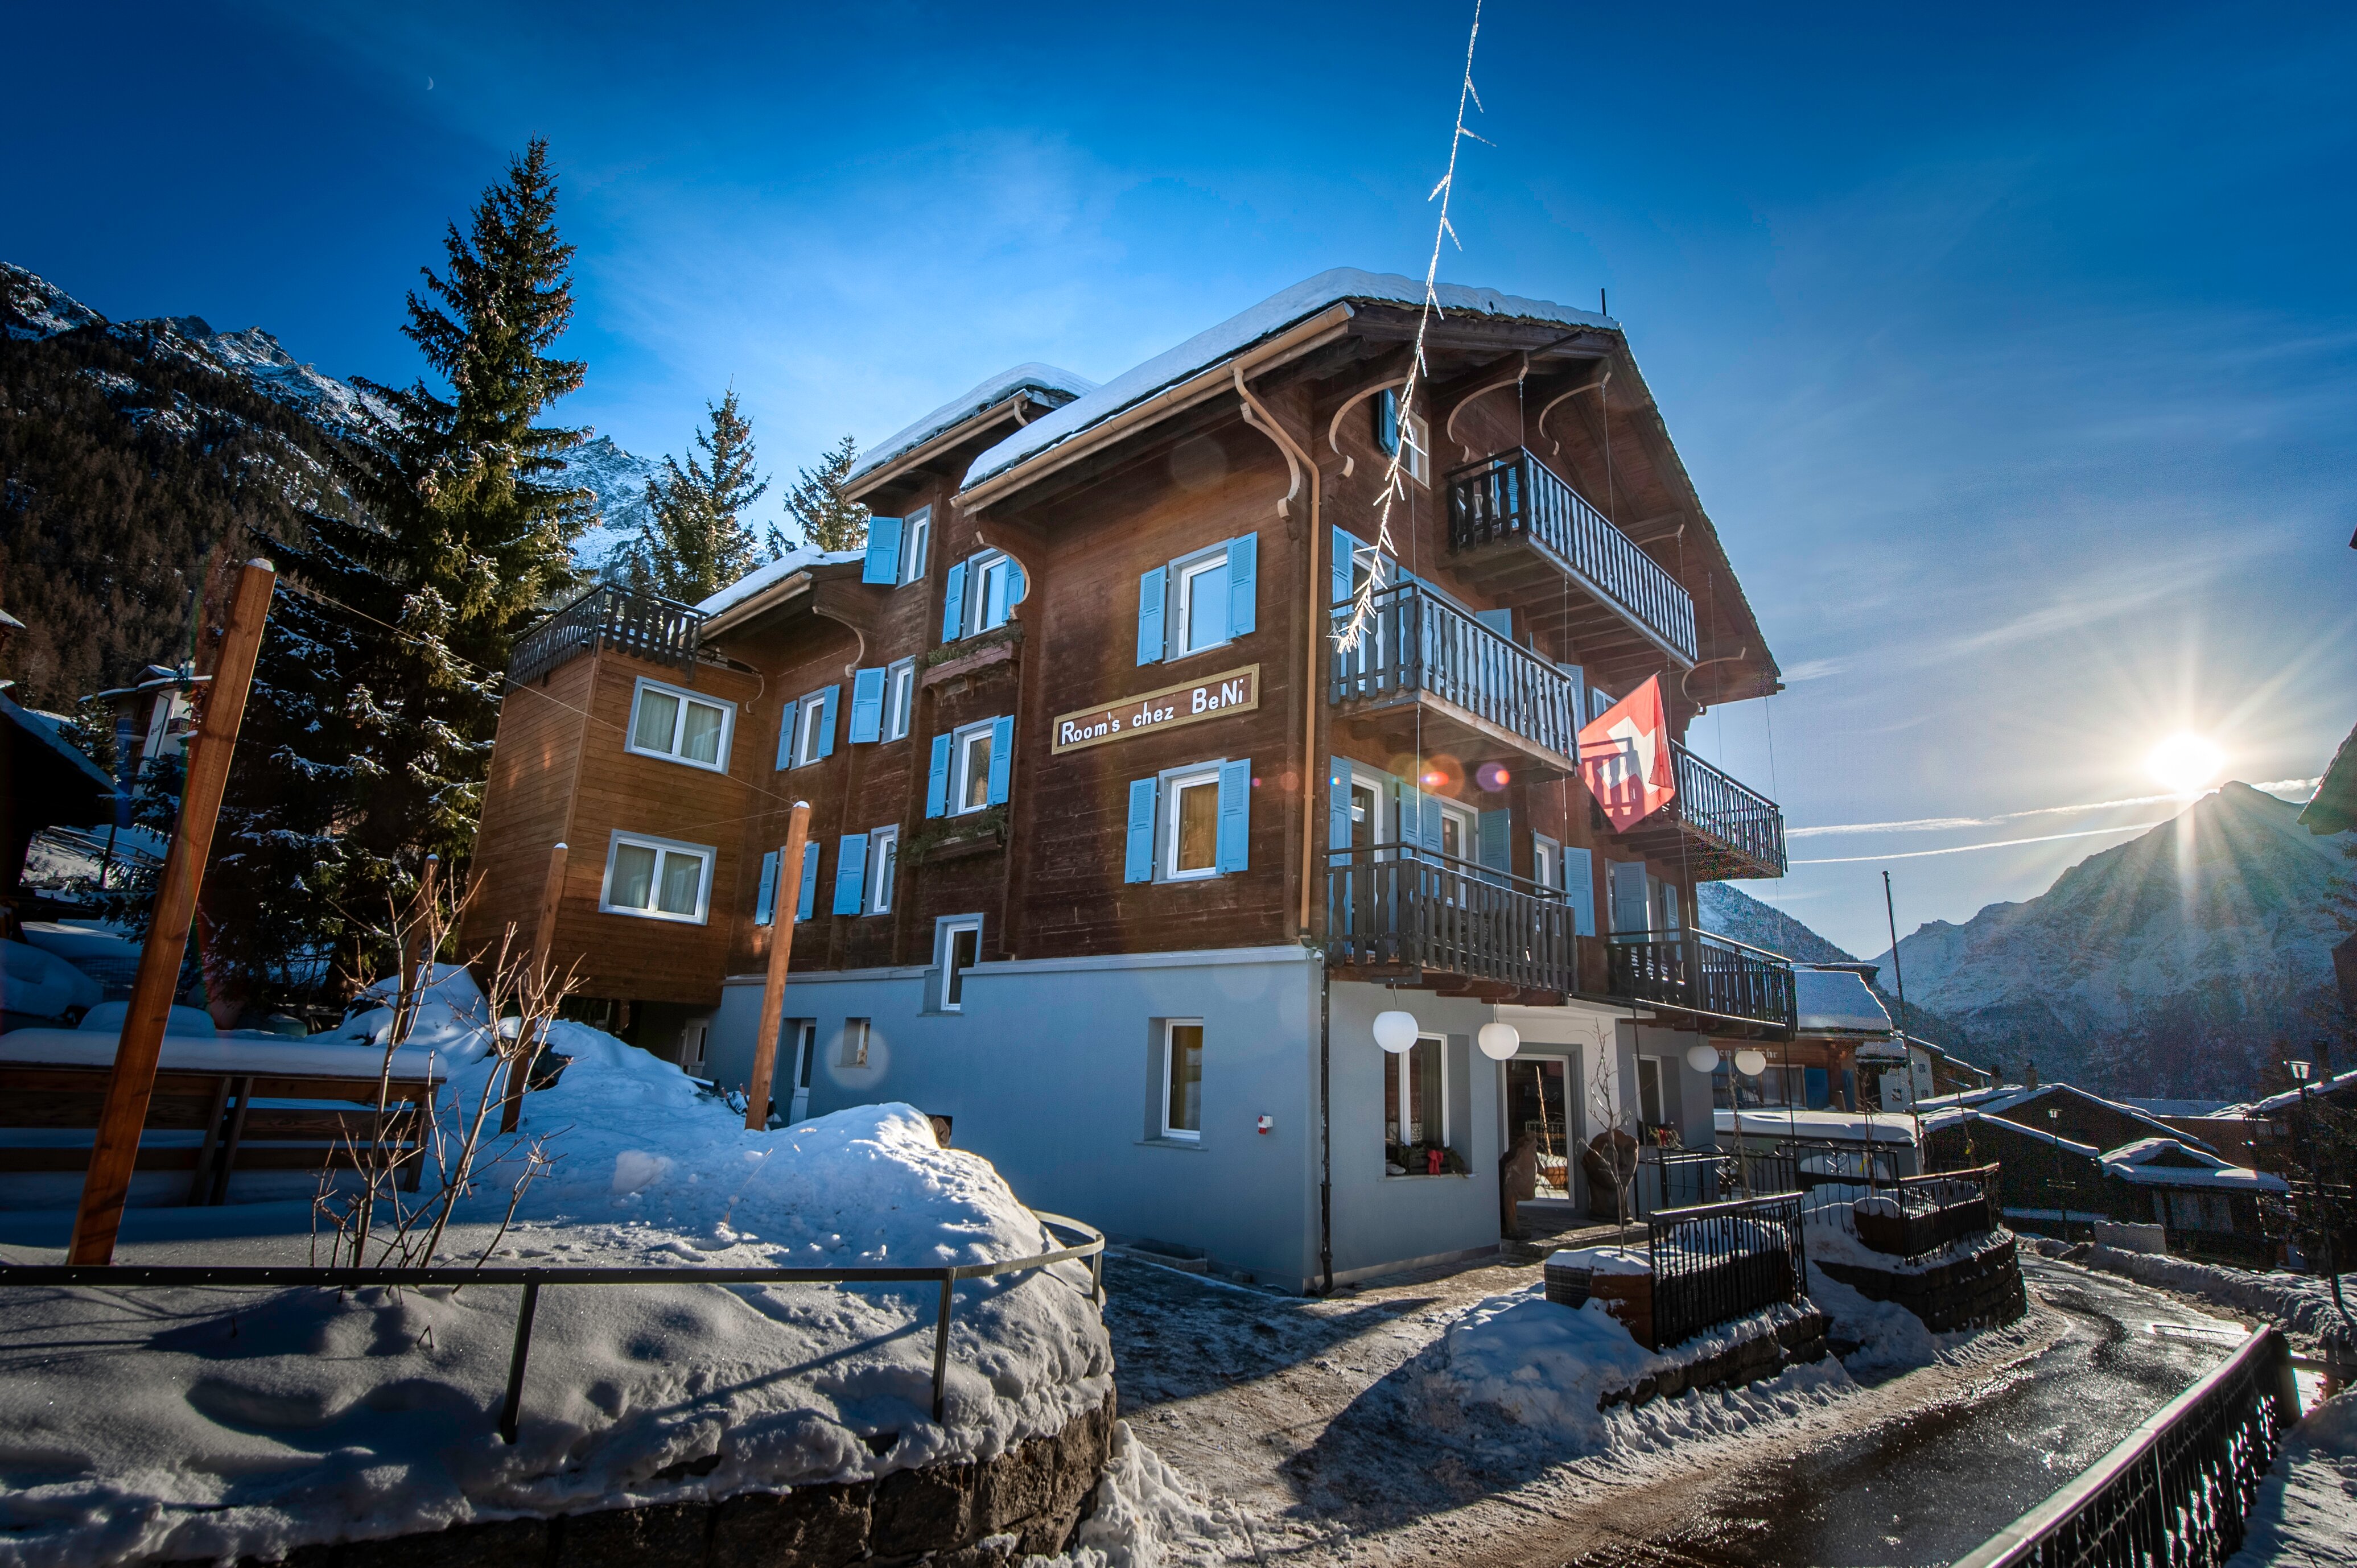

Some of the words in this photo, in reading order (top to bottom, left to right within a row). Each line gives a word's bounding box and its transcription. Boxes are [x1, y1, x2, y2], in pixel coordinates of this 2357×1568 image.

[1061, 712, 1120, 745] Room's
[1132, 702, 1175, 728] chez
[1191, 678, 1244, 715] BeNi
